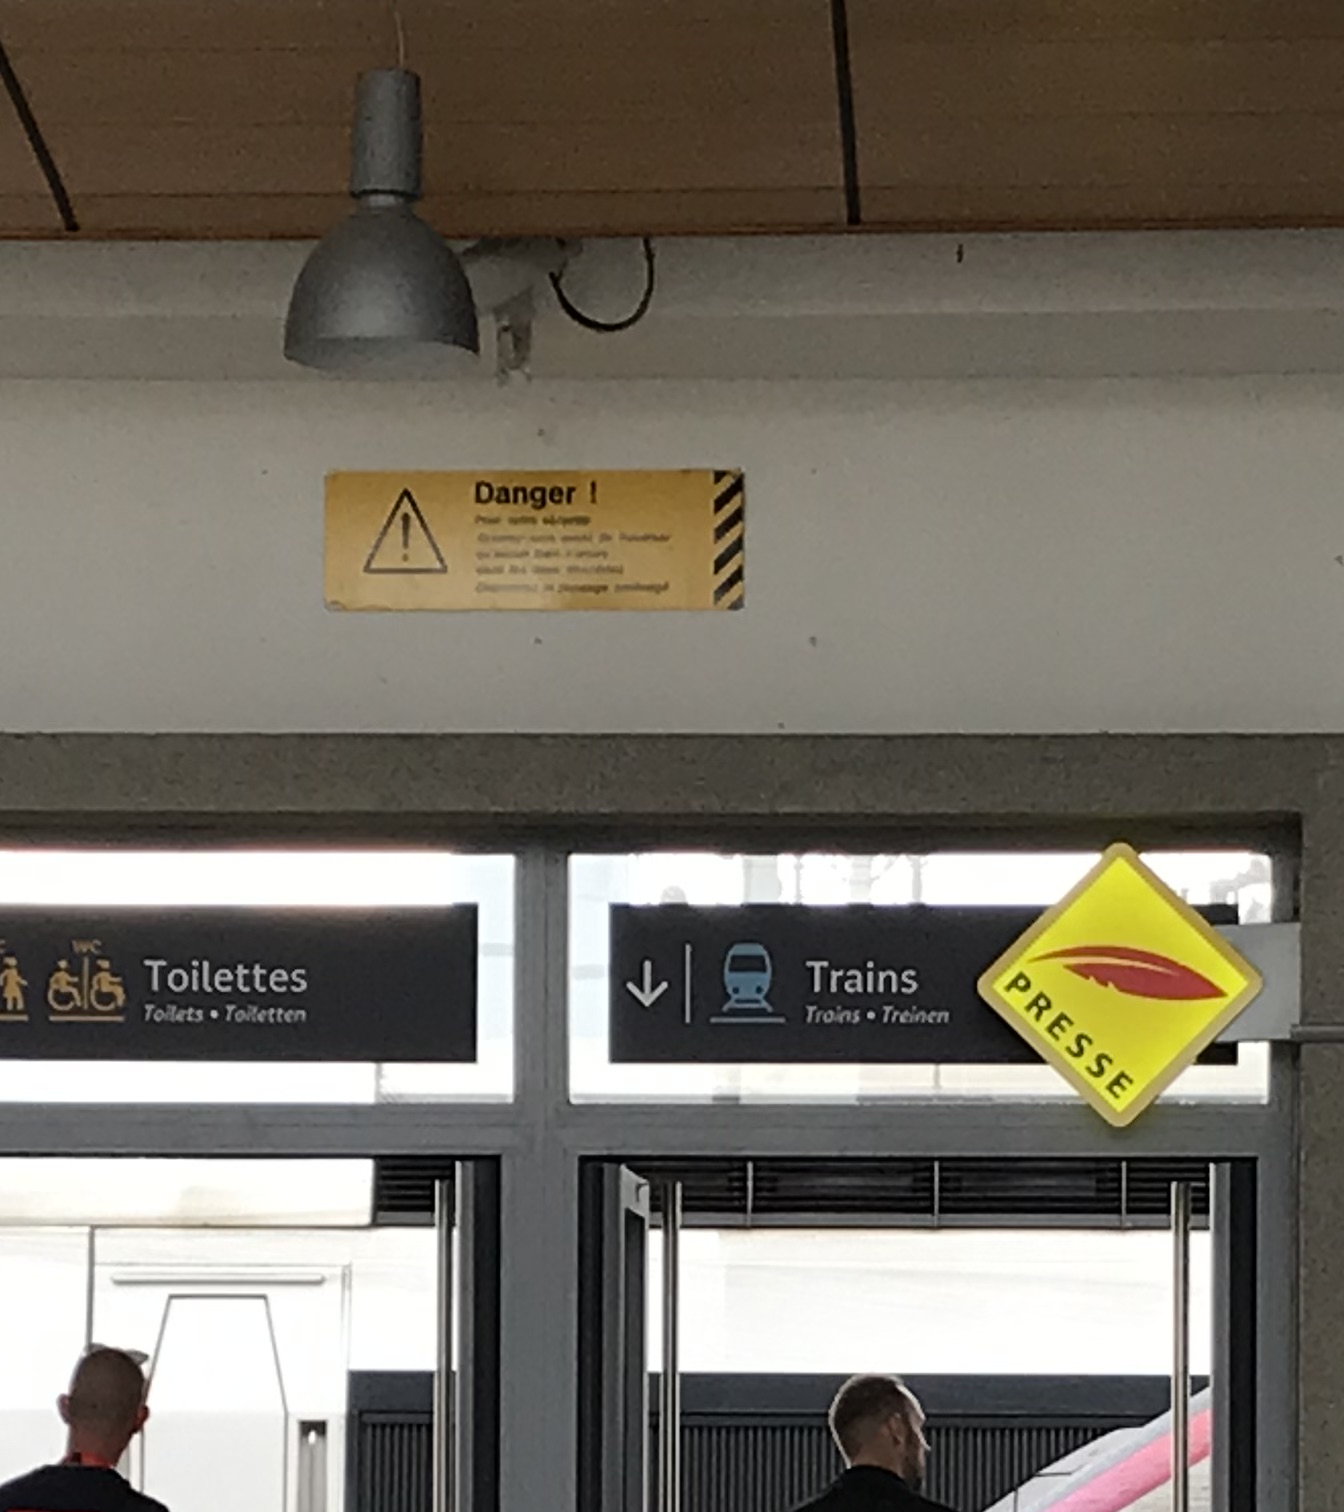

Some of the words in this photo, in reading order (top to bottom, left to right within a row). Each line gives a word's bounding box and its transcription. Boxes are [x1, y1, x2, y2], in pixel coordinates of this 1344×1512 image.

[473, 480, 577, 511] Danger
[589, 480, 598, 505] !
[143, 959, 308, 993] Toilettes
[805, 960, 919, 994] Trains
[144, 1005, 204, 1023] Toilets
[225, 1004, 307, 1023] Toiletten
[805, 1005, 861, 1024] Trains
[882, 1005, 950, 1024] Treinen
[1002, 970, 1135, 1100] PRESSE
